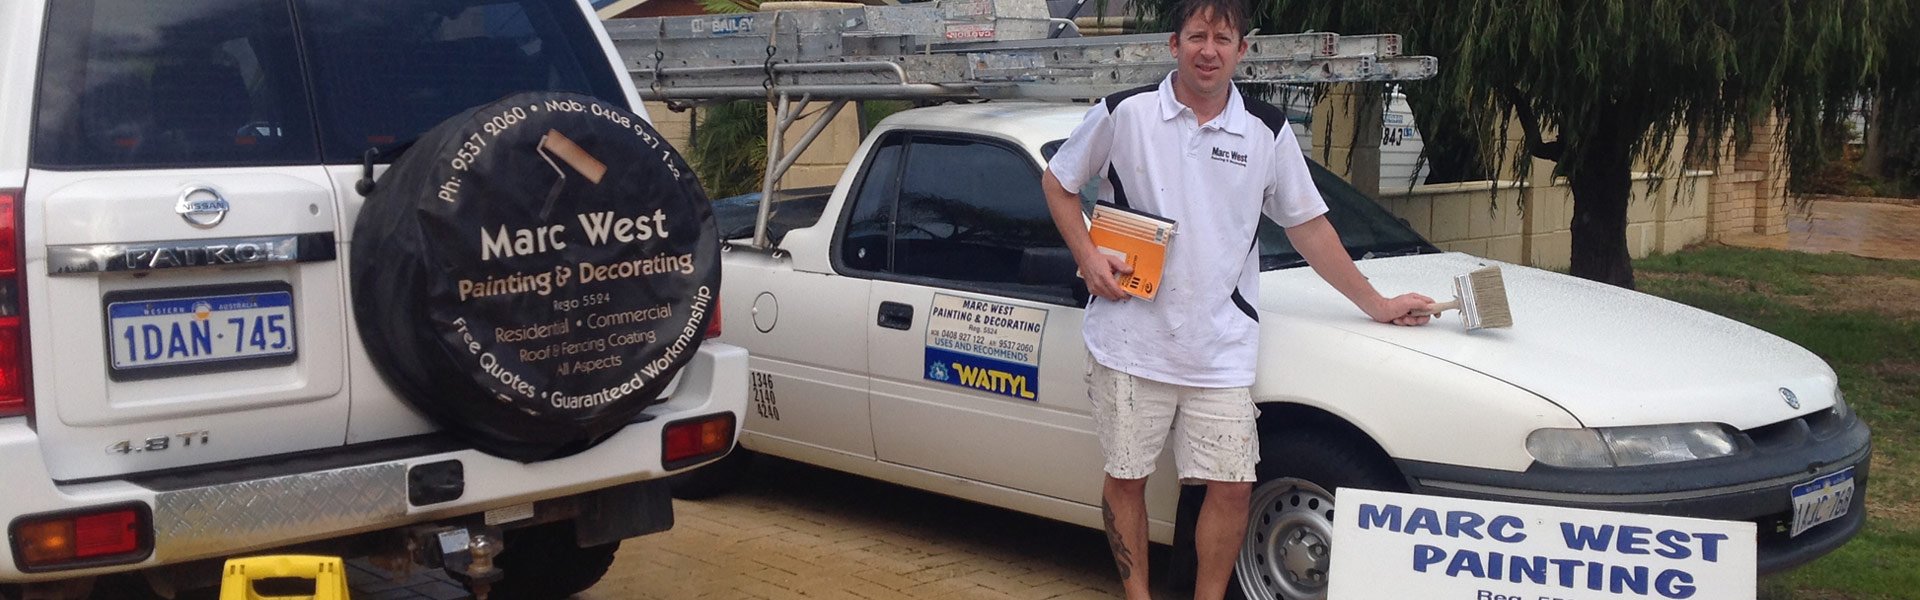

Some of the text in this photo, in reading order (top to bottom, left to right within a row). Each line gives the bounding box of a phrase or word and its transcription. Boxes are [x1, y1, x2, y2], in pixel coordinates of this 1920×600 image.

[438, 174, 462, 202] Ph:
[451, 132, 487, 172] 9537
[483, 106, 527, 136] 2060
[545, 100, 587, 113] Mob:
[591, 103, 631, 129] 0408
[634, 124, 660, 149] 927
[1212, 146, 1230, 158] Marc
[1231, 150, 1248, 163] West
[182, 202, 225, 210] NISSAN
[481, 208, 669, 261] Marc West
[125, 242, 289, 269] PATROL
[458, 252, 695, 302] Painting & Decorating
[143, 302, 259, 316] WESTERN AUSTRALIA
[582, 293, 611, 307] 5524
[962, 300, 1015, 316] MARC WEST
[494, 303, 673, 343] Residential Commercial
[932, 306, 1041, 334] PAINTING & DECORATING
[452, 285, 712, 410] Free Quotes Guaranteed Workmanship
[519, 347, 551, 363] Roof
[561, 339, 606, 356] Fencing
[608, 329, 658, 348] Coating
[934, 337, 1029, 362] USES AND RECOMMENDS
[941, 330, 958, 340] 0408
[958, 333, 972, 342] 927
[973, 335, 985, 345] 122
[998, 339, 1016, 350] 9537
[1016, 342, 1034, 353] 2060
[572, 354, 623, 374] Aspects
[752, 372, 773, 389] 1346
[951, 362, 1035, 399] WATTYL
[753, 387, 776, 405] 2140
[758, 403, 779, 420] 4240
[1358, 503, 1729, 563] MARC WEST
[1412, 544, 1697, 599] PAINTING
